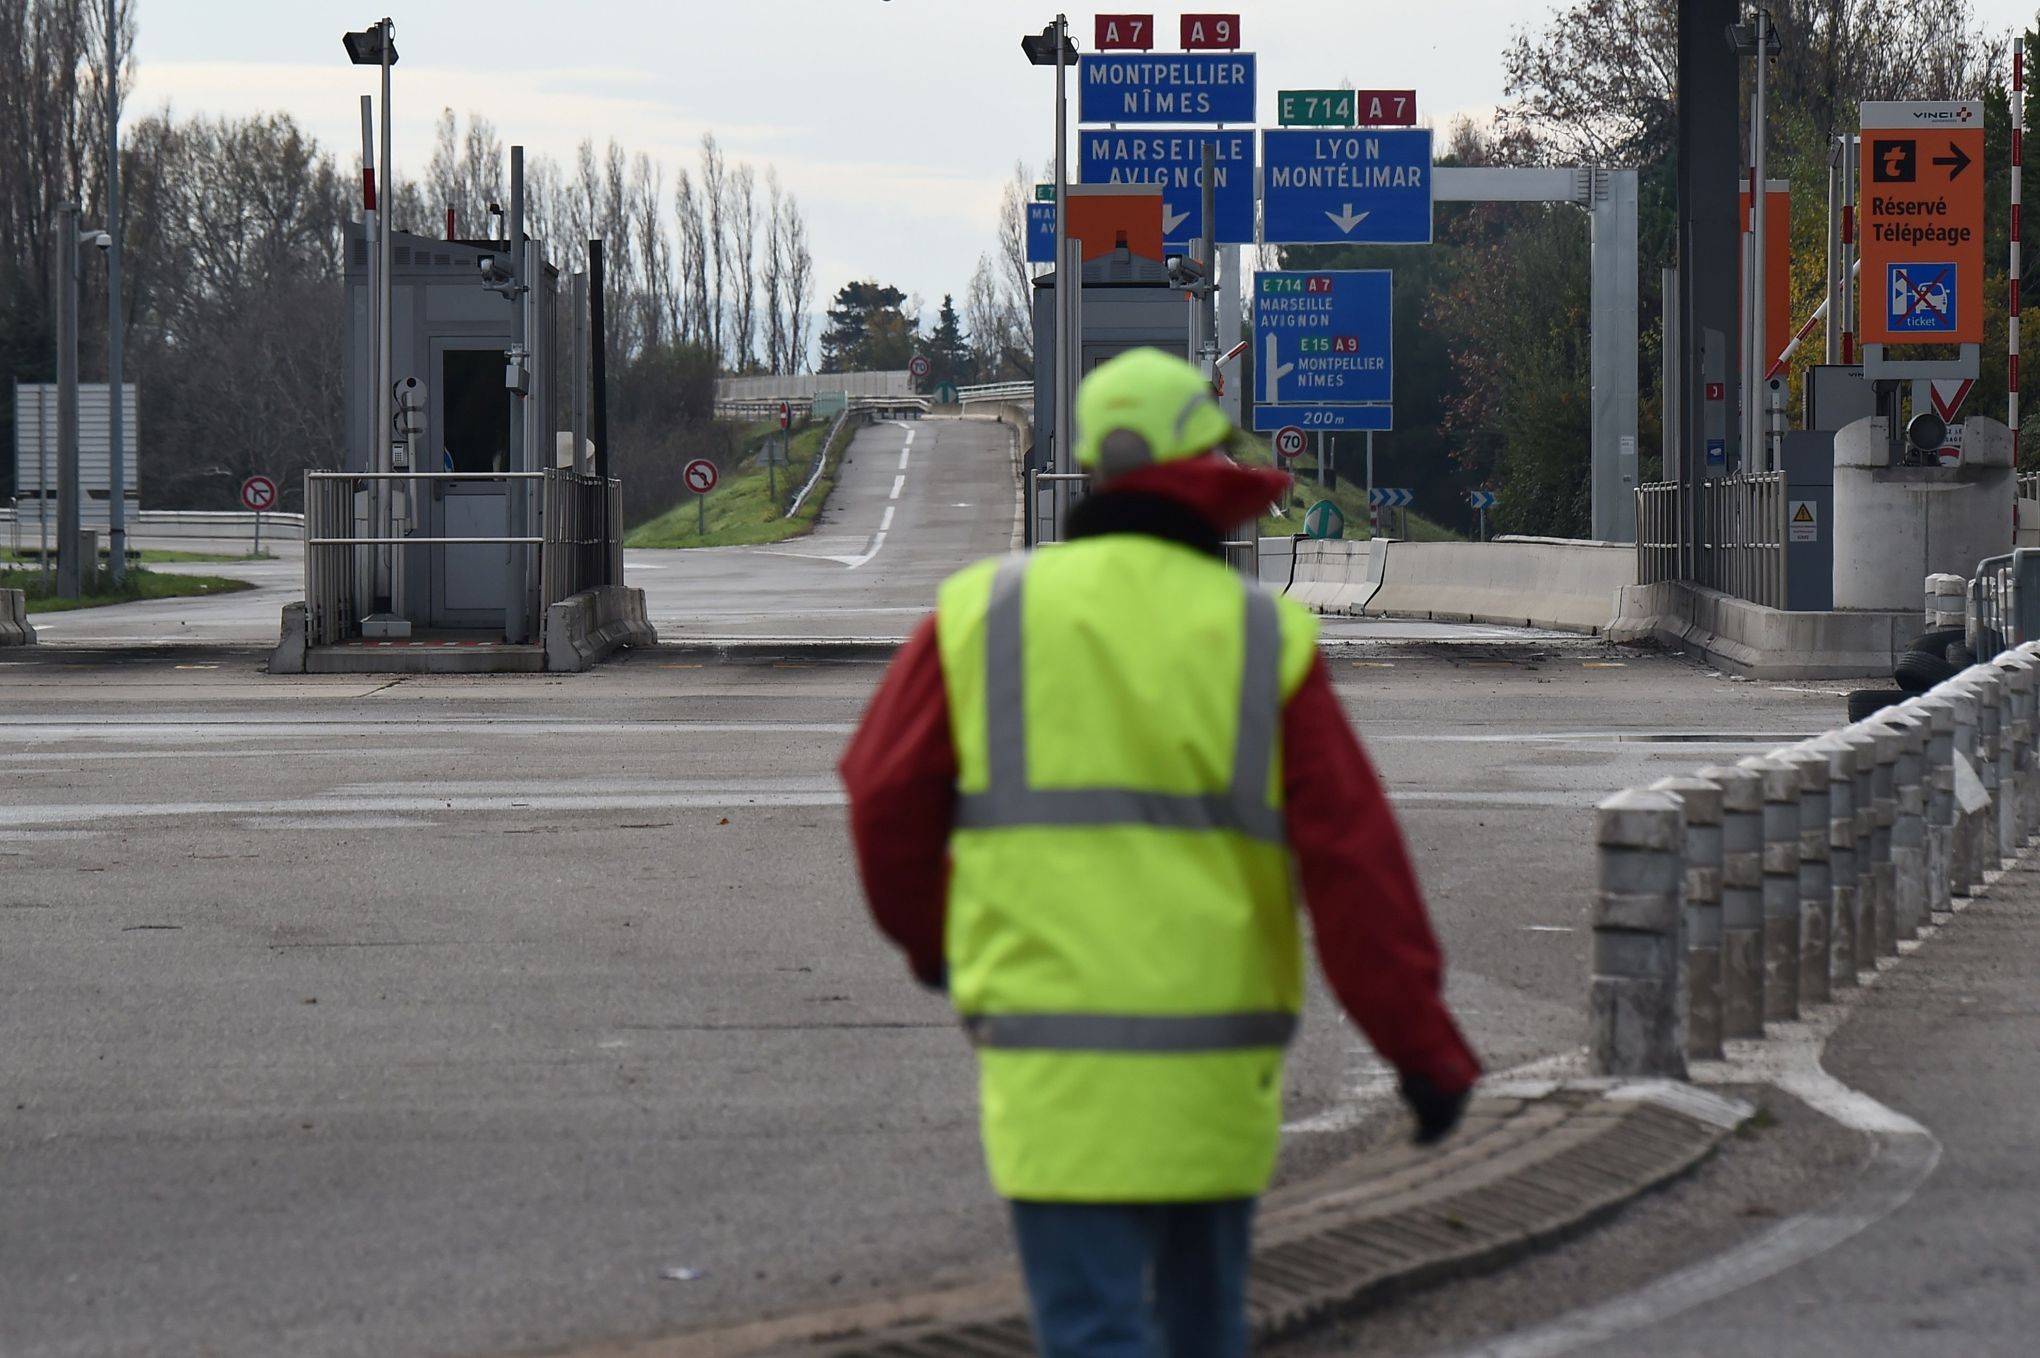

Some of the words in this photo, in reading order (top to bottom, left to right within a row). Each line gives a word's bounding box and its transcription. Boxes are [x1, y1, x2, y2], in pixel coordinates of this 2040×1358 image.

[1105, 21, 1119, 43] A
[1129, 21, 1143, 42] 7
[1190, 21, 1205, 43] A
[1215, 20, 1230, 42] 9
[1089, 63, 1246, 85] MONTPELLIER
[1124, 89, 1210, 113] NÎMES
[1283, 97, 1295, 119] E
[1305, 97, 1350, 119] 714
[1369, 97, 1382, 119] A
[1392, 97, 1406, 119] 7
[1315, 138, 1380, 160] LYON
[1273, 162, 1421, 188] MONTÉLIMAR
[1872, 196, 1947, 216] Réservé
[1873, 222, 1971, 247] Télépéage
[1262, 280, 1270, 292] E
[1275, 279, 1302, 292] 714
[1308, 279, 1317, 291] A
[1322, 279, 1331, 291] 7
[1260, 298, 1333, 310] MARSEILLE
[1261, 315, 1329, 327] AVIGNON
[1907, 316, 1936, 327] ticket
[1300, 338, 1308, 351] E
[1312, 338, 1329, 351] 15
[1335, 338, 1344, 351] A
[1348, 338, 1358, 351] 9
[914, 362, 926, 372] 70
[1298, 357, 1384, 370] MONTPELLIER
[1298, 372, 1344, 387] NÎMES
[1282, 435, 1300, 449] 70
